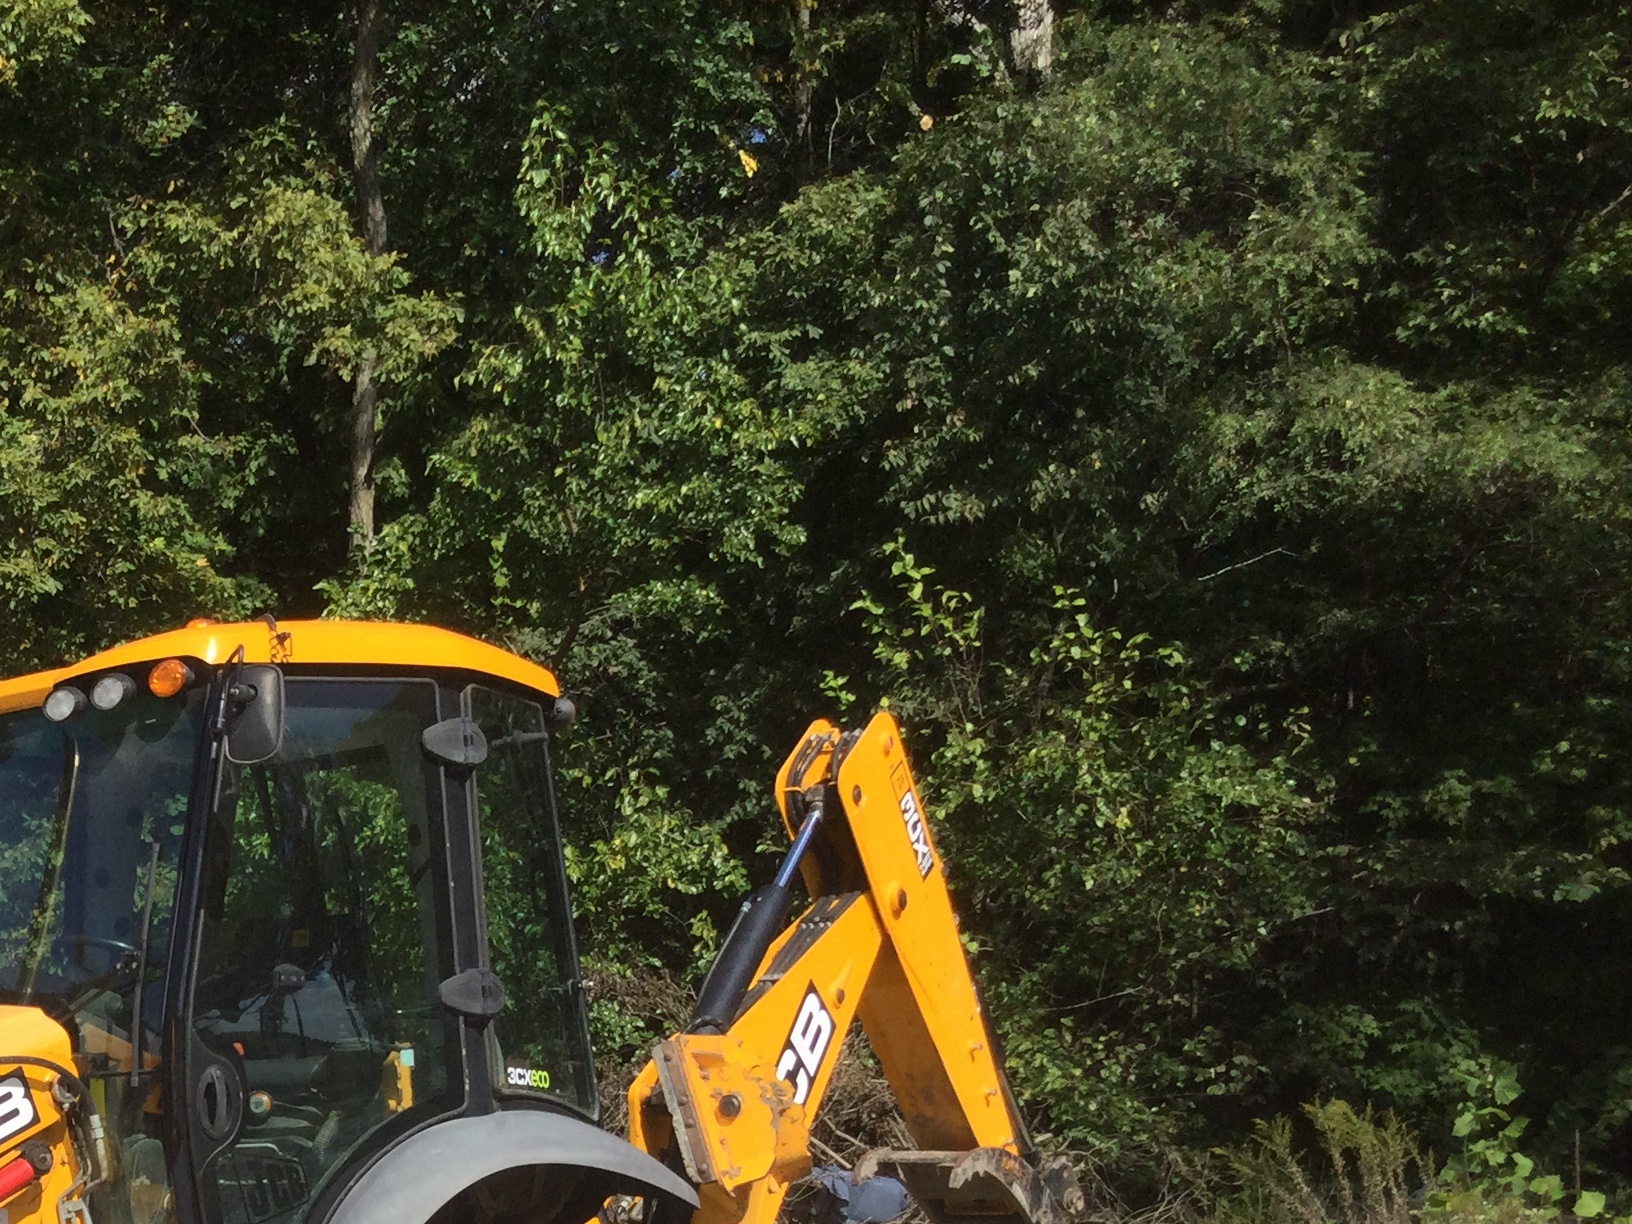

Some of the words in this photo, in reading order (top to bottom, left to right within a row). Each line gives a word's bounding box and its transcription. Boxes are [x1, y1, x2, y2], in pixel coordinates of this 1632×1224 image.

[900, 791, 929, 865] 3CX
[507, 1067, 550, 1089] 3CXeco
[775, 992, 832, 1105] CB
